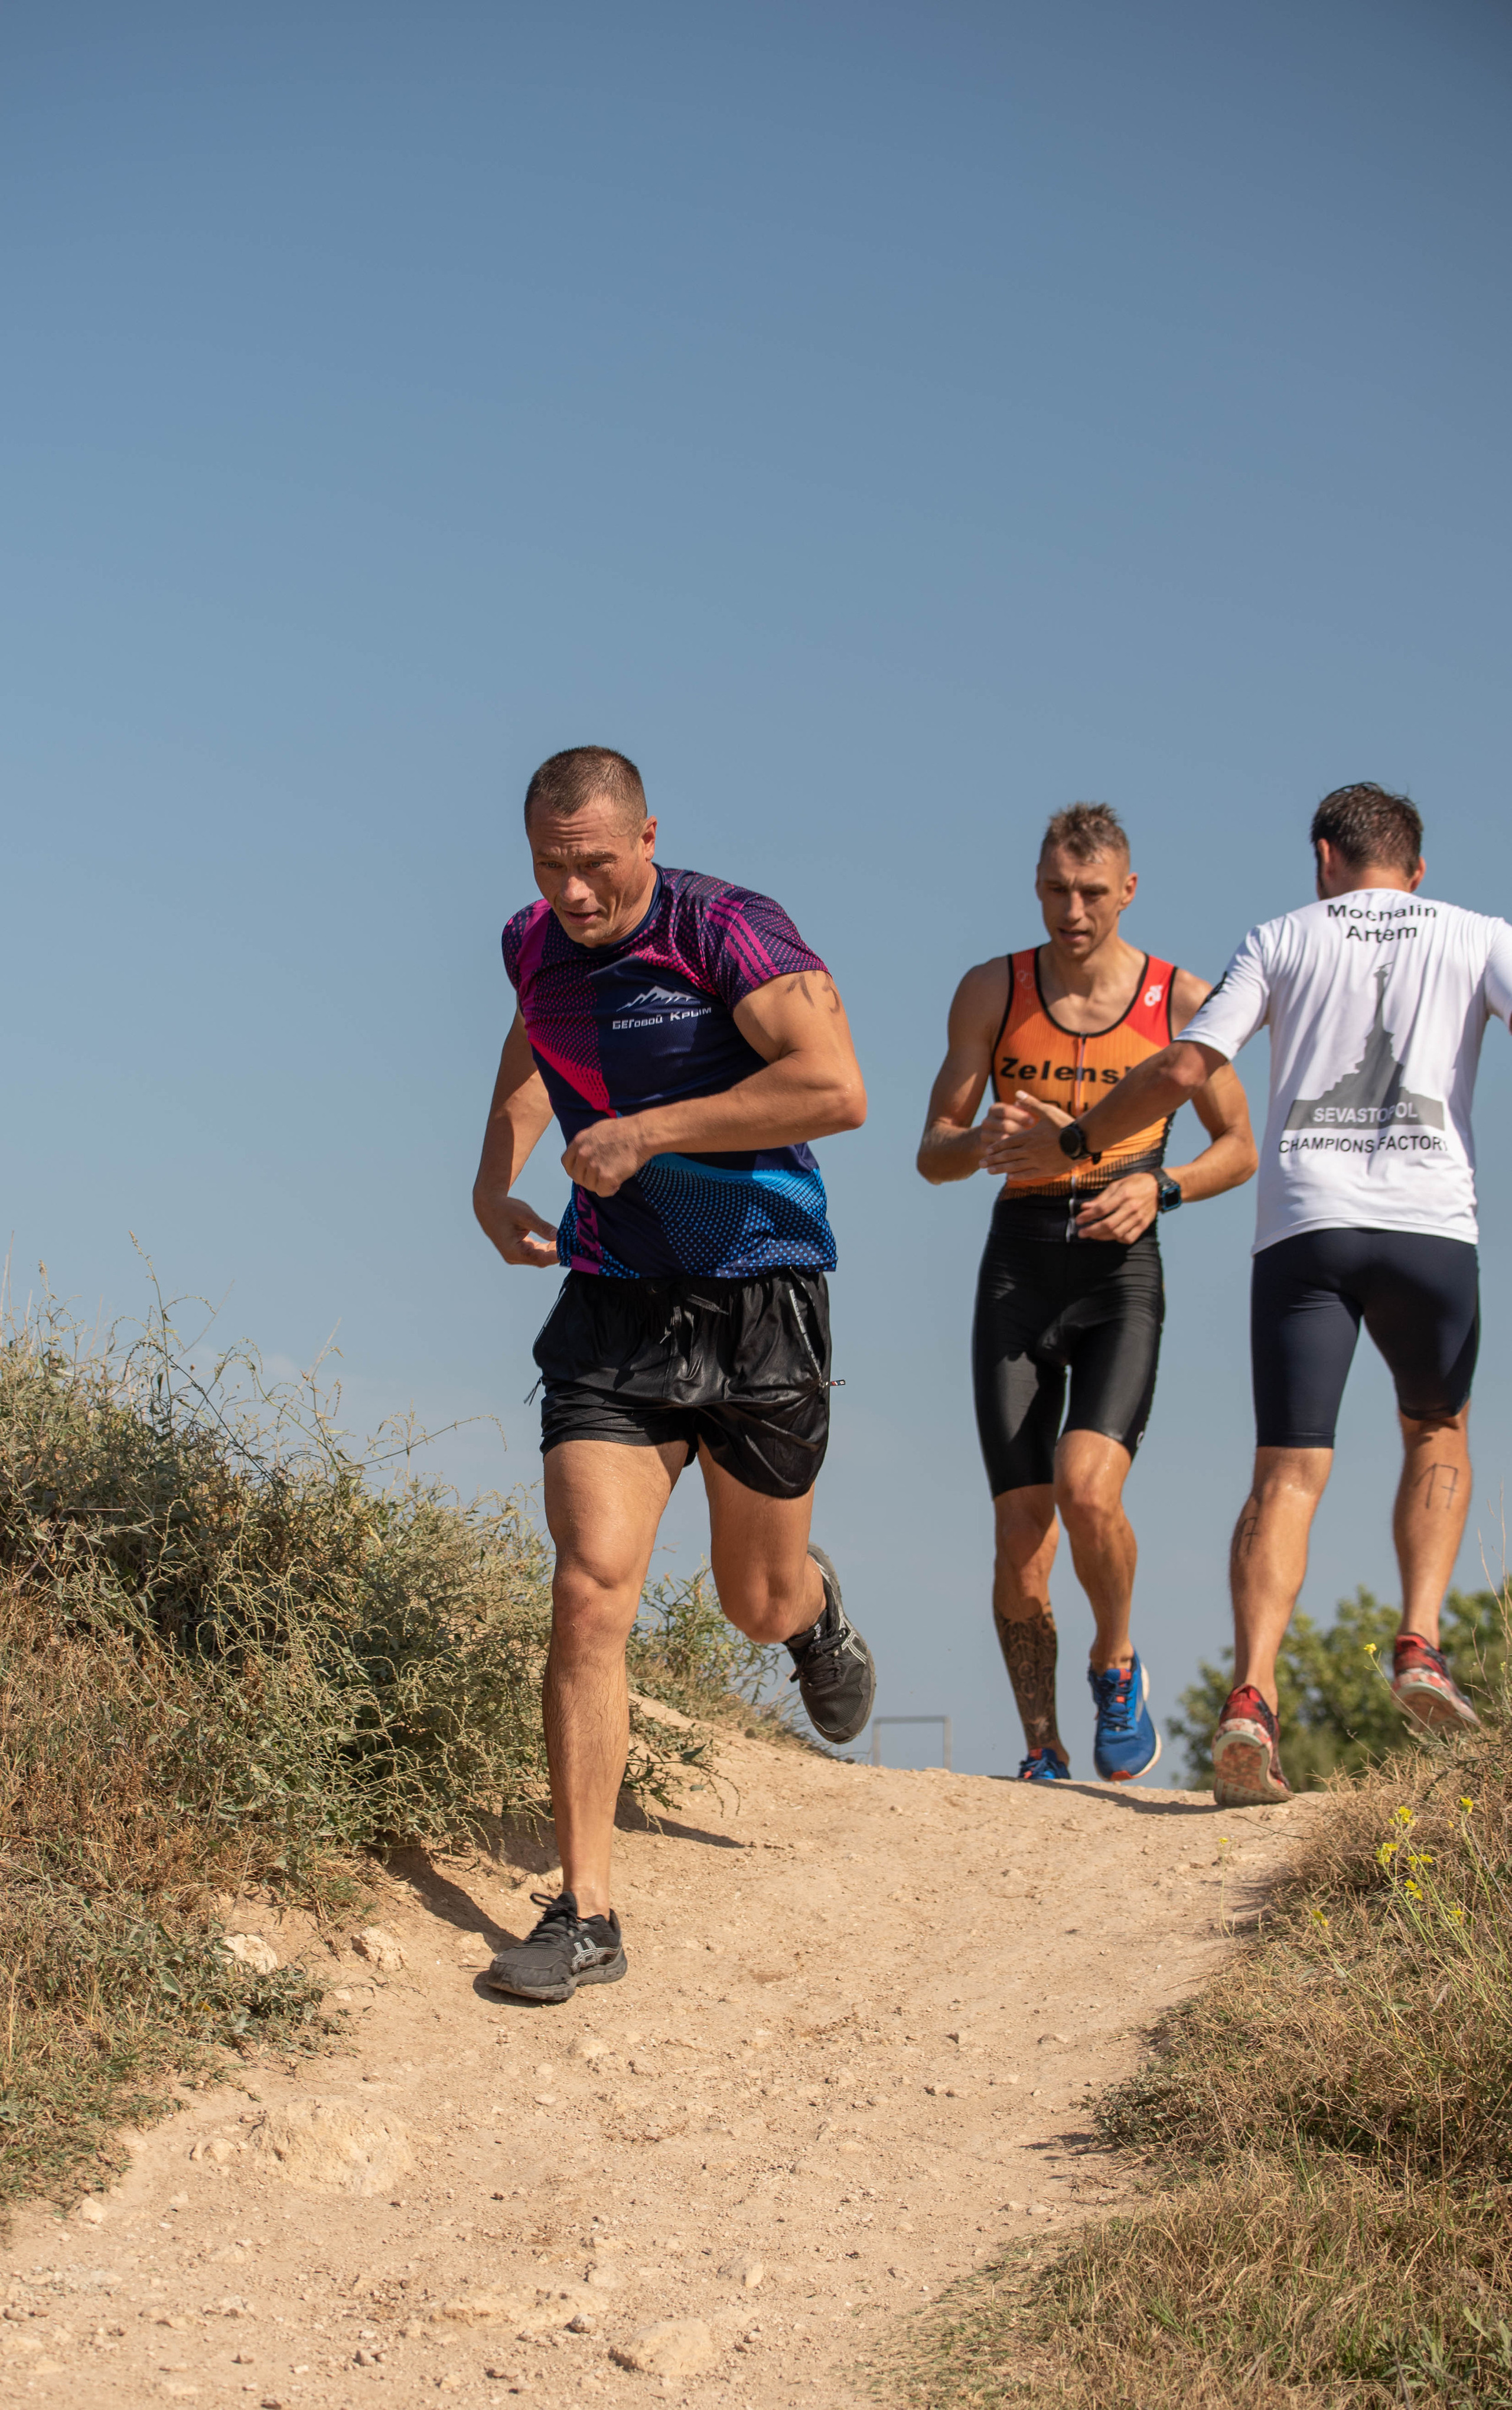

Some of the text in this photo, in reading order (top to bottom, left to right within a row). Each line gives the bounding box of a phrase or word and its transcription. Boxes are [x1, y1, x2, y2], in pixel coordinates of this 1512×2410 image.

[1345, 926, 1417, 943] Artem
[1000, 1057, 1132, 1084] Zelens
[1279, 1136, 1374, 1153] CHAMPIONS
